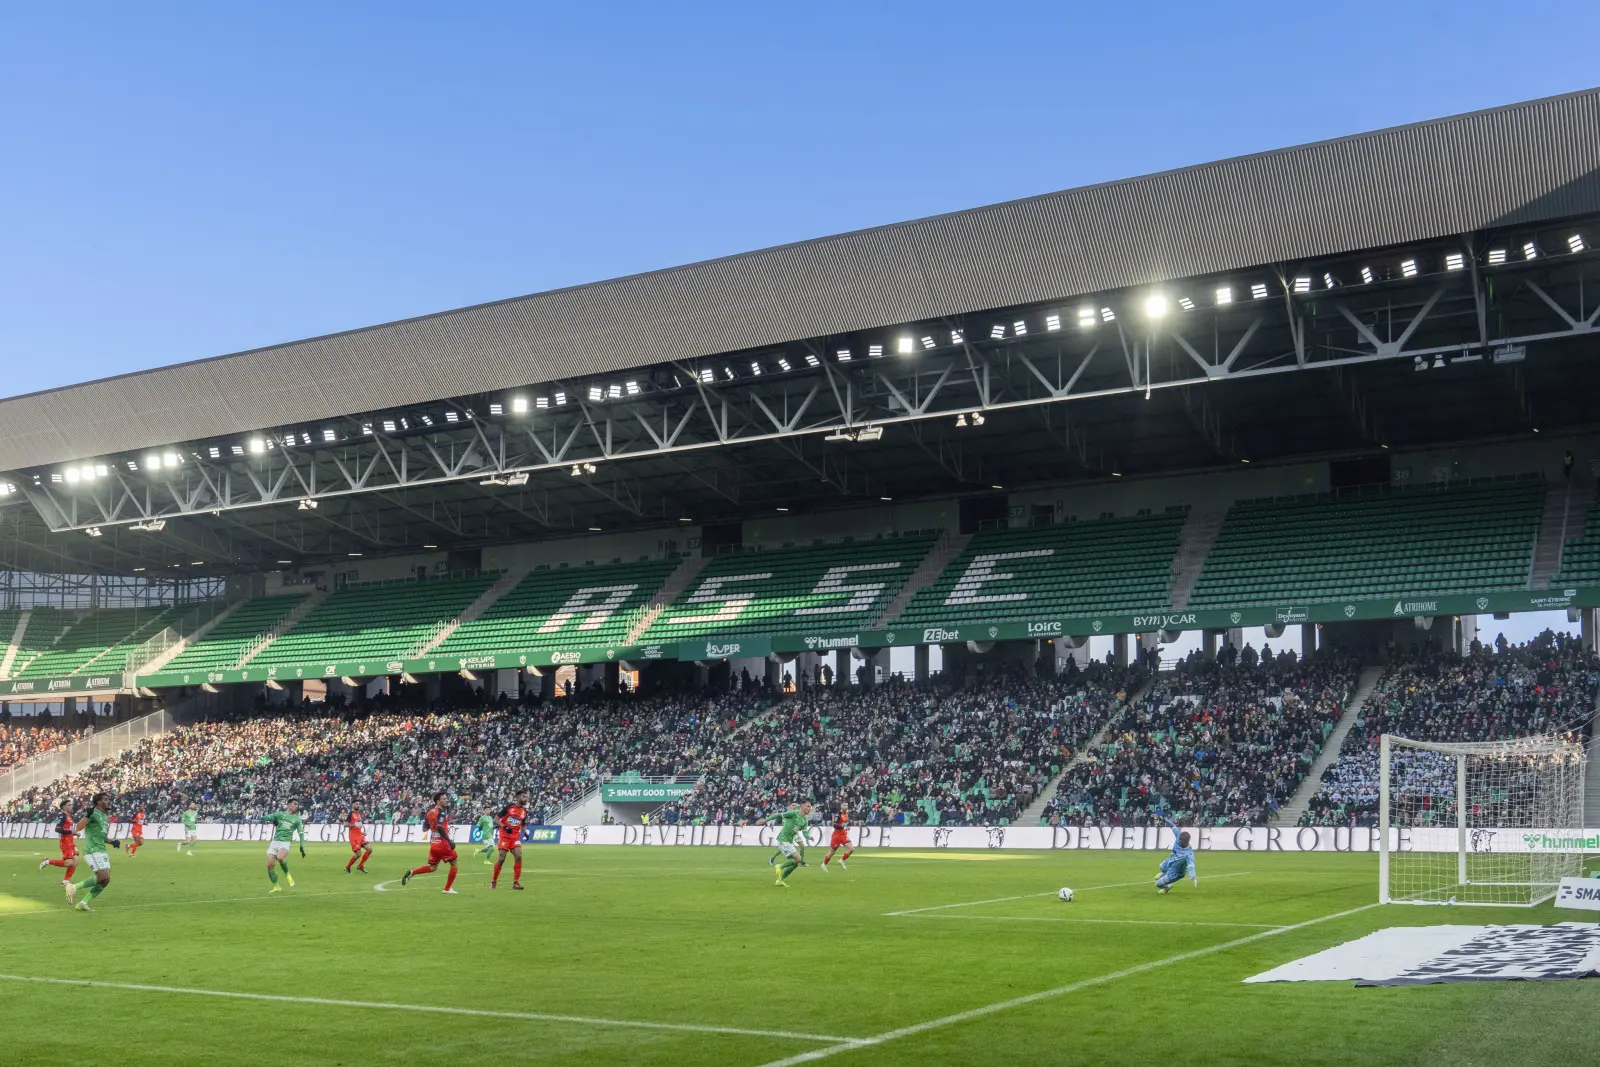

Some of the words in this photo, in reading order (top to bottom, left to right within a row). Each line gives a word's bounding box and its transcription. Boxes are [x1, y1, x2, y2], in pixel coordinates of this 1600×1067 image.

[1404, 601, 1437, 612] ATRIHOME
[1133, 614, 1197, 628] BYmyCAR
[818, 634, 859, 648] hummel
[923, 629, 960, 643] ZEbet
[616, 789, 642, 797] SMART
[643, 789, 665, 797] GOOD
[320, 823, 416, 843] GRUPE
[533, 829, 557, 839] BKT
[622, 825, 743, 846] DEVEILLE
[1052, 826, 1212, 850] DEVEILE
[1541, 834, 1600, 849] hummel
